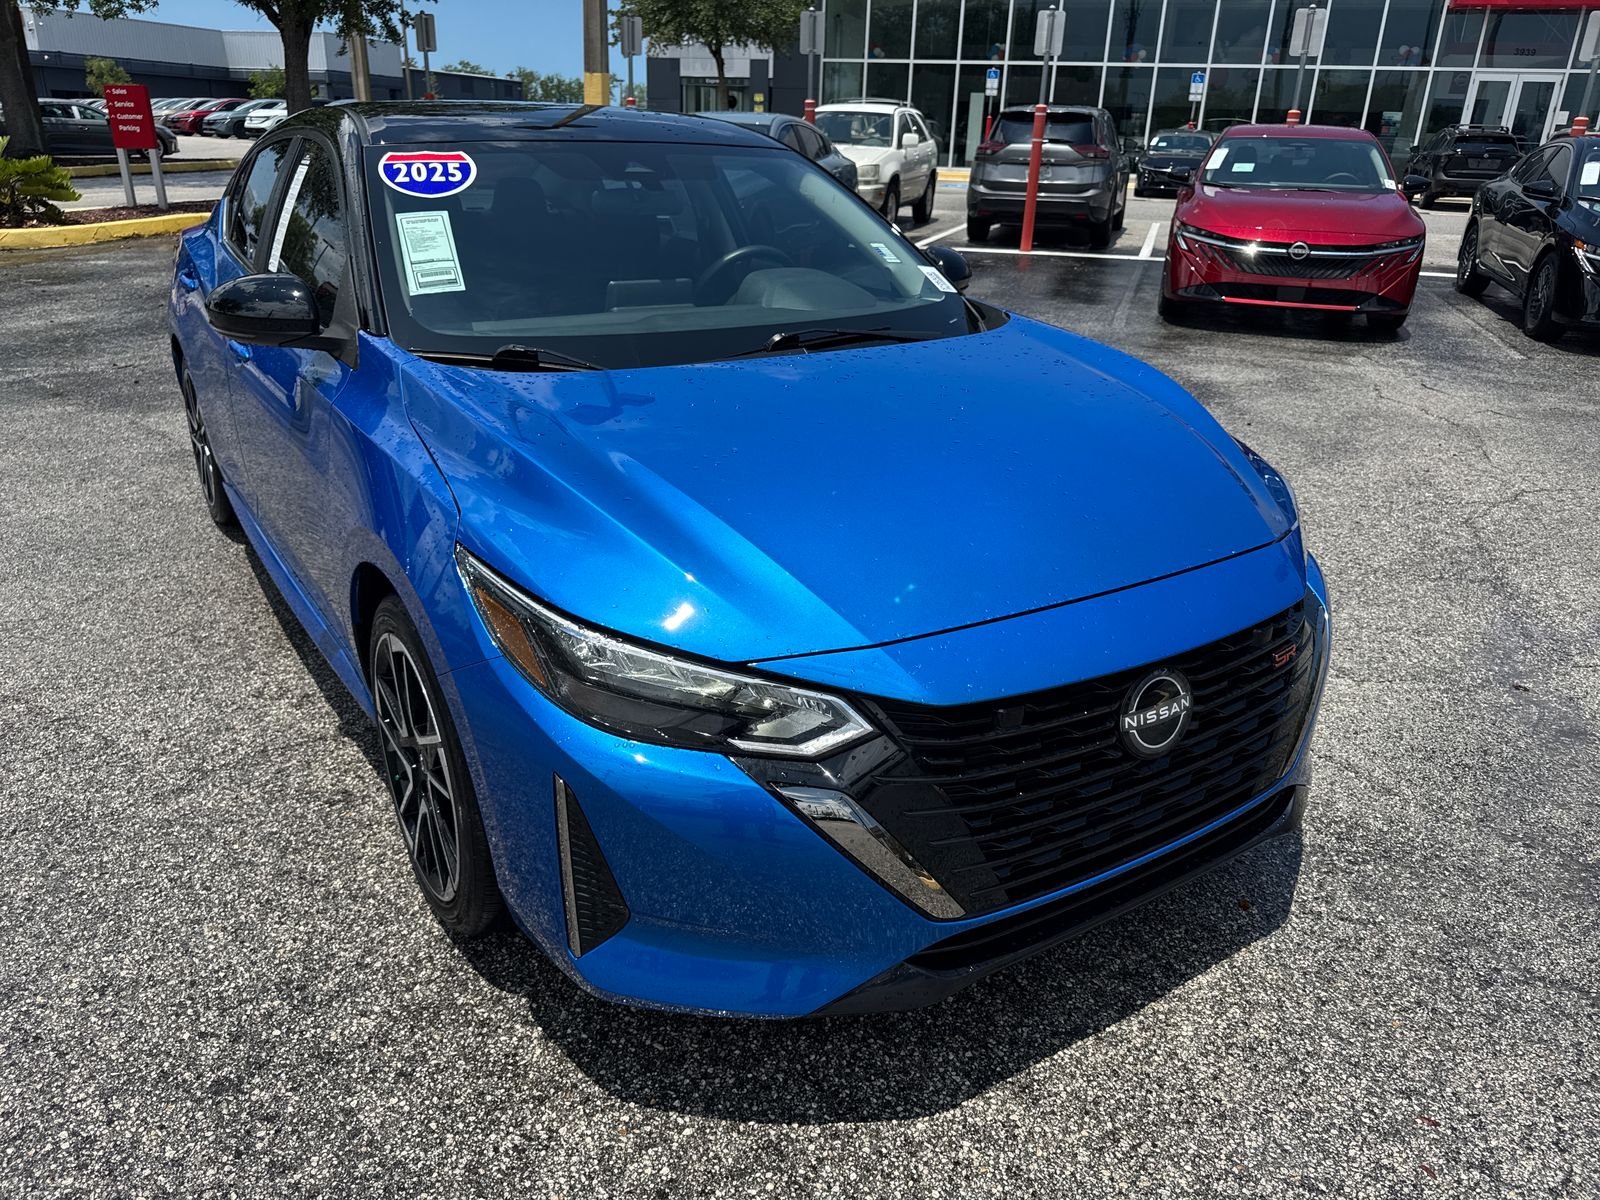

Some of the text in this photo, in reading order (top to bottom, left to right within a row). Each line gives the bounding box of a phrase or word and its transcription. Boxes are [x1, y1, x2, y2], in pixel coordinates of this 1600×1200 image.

[1513, 48, 1536, 56] 3939
[393, 163, 462, 182] 2025
[1274, 644, 1296, 668] SR
[1124, 696, 1190, 728] NISSAN
